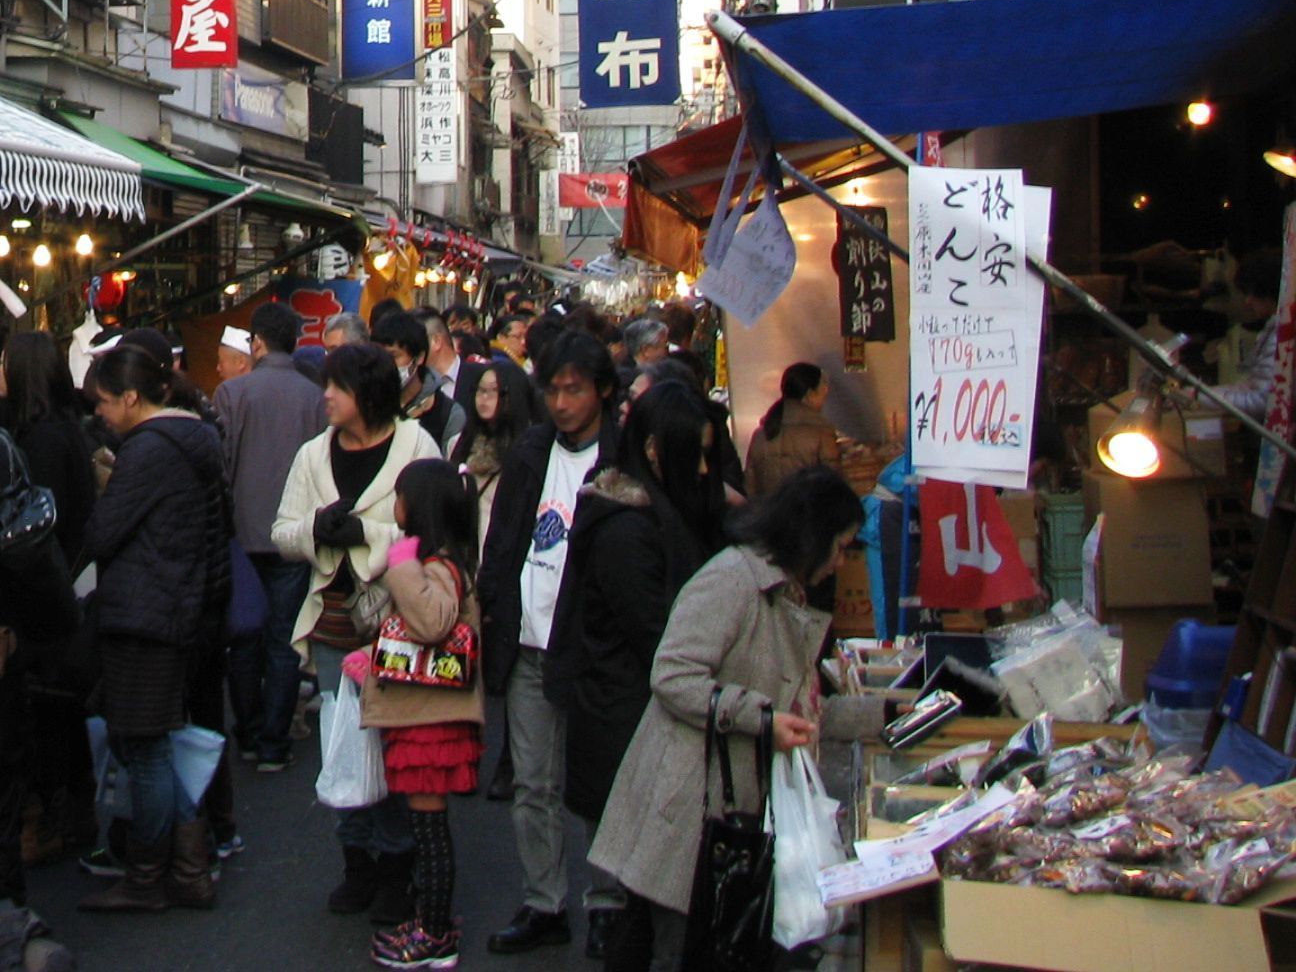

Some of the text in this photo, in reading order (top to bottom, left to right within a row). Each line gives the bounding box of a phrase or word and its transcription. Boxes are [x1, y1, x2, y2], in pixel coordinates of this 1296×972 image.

[420, 132, 452, 146] ミヤコ
[420, 149, 452, 163] 大三
[934, 180, 979, 307] どんこ
[981, 175, 1015, 287] 格安
